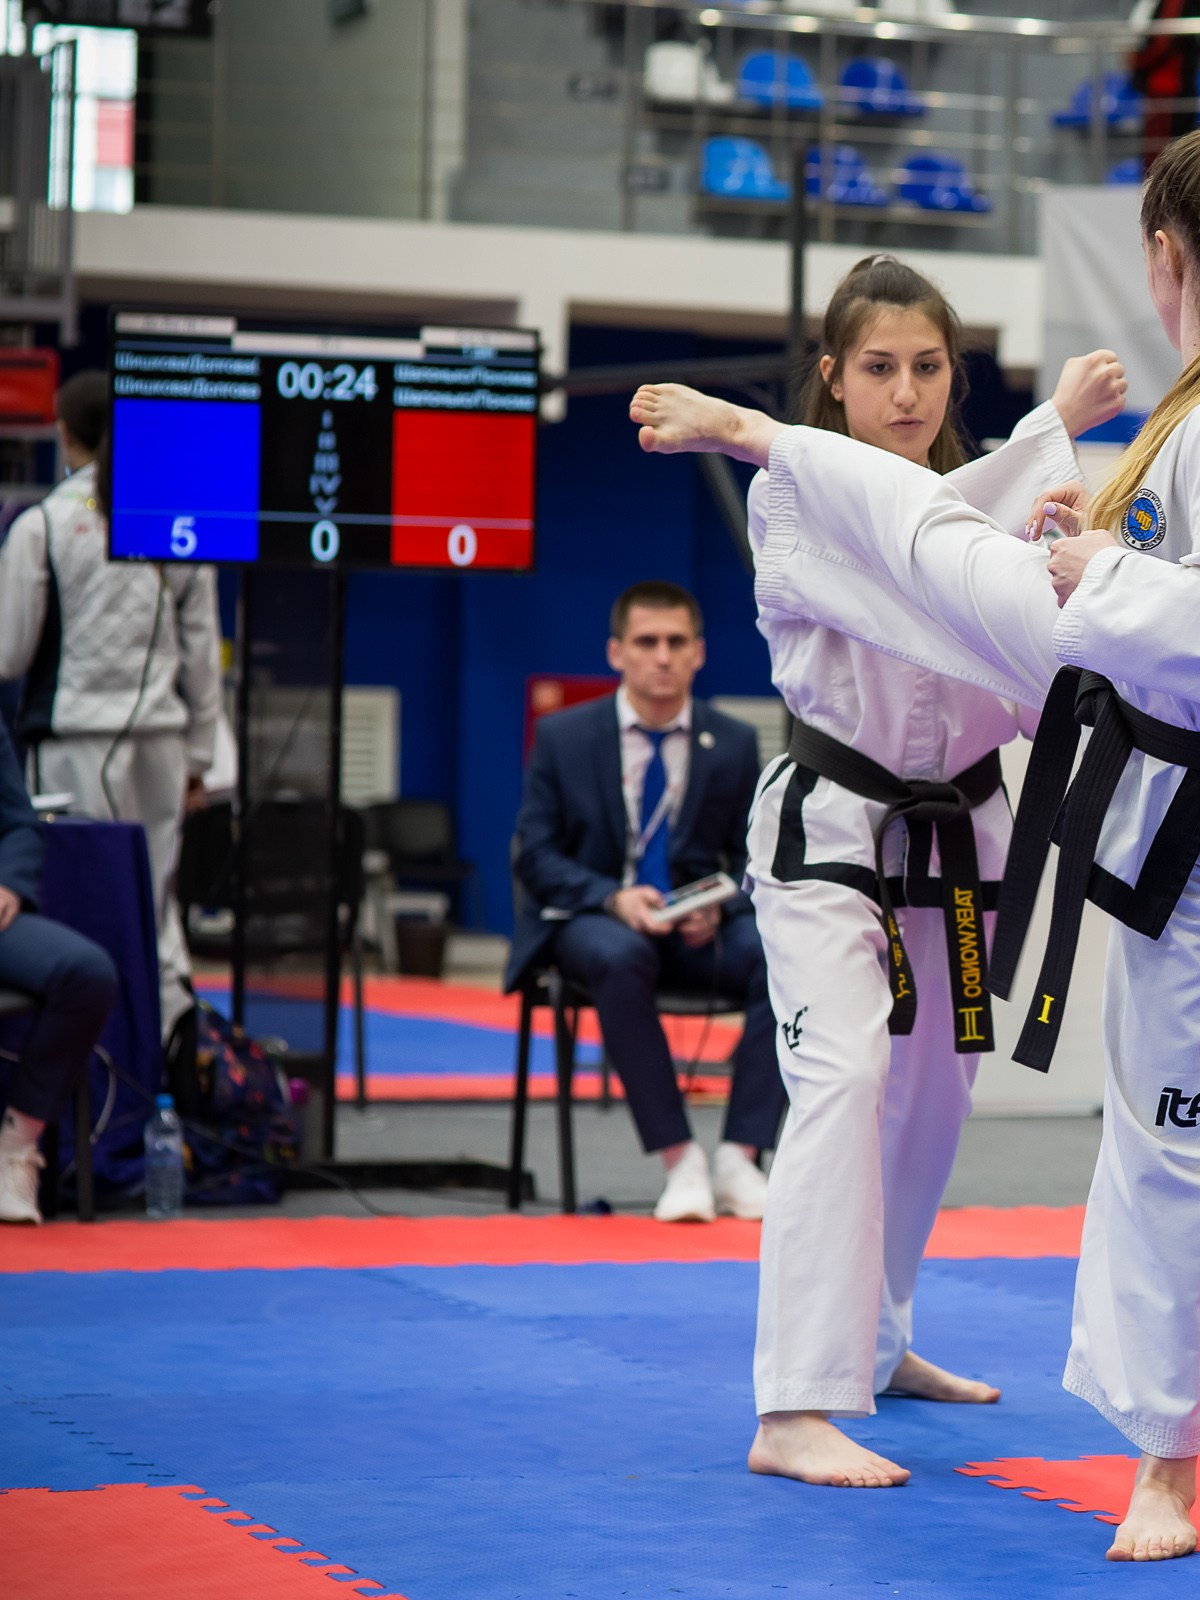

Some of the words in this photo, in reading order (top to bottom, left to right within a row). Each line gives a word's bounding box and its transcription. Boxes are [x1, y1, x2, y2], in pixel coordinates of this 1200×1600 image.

[277, 361, 379, 402] 00:24
[170, 516, 198, 558] 5
[310, 519, 340, 562] 0
[447, 524, 478, 567] 0
[958, 1006, 985, 1041] II
[1037, 994, 1055, 1024] I
